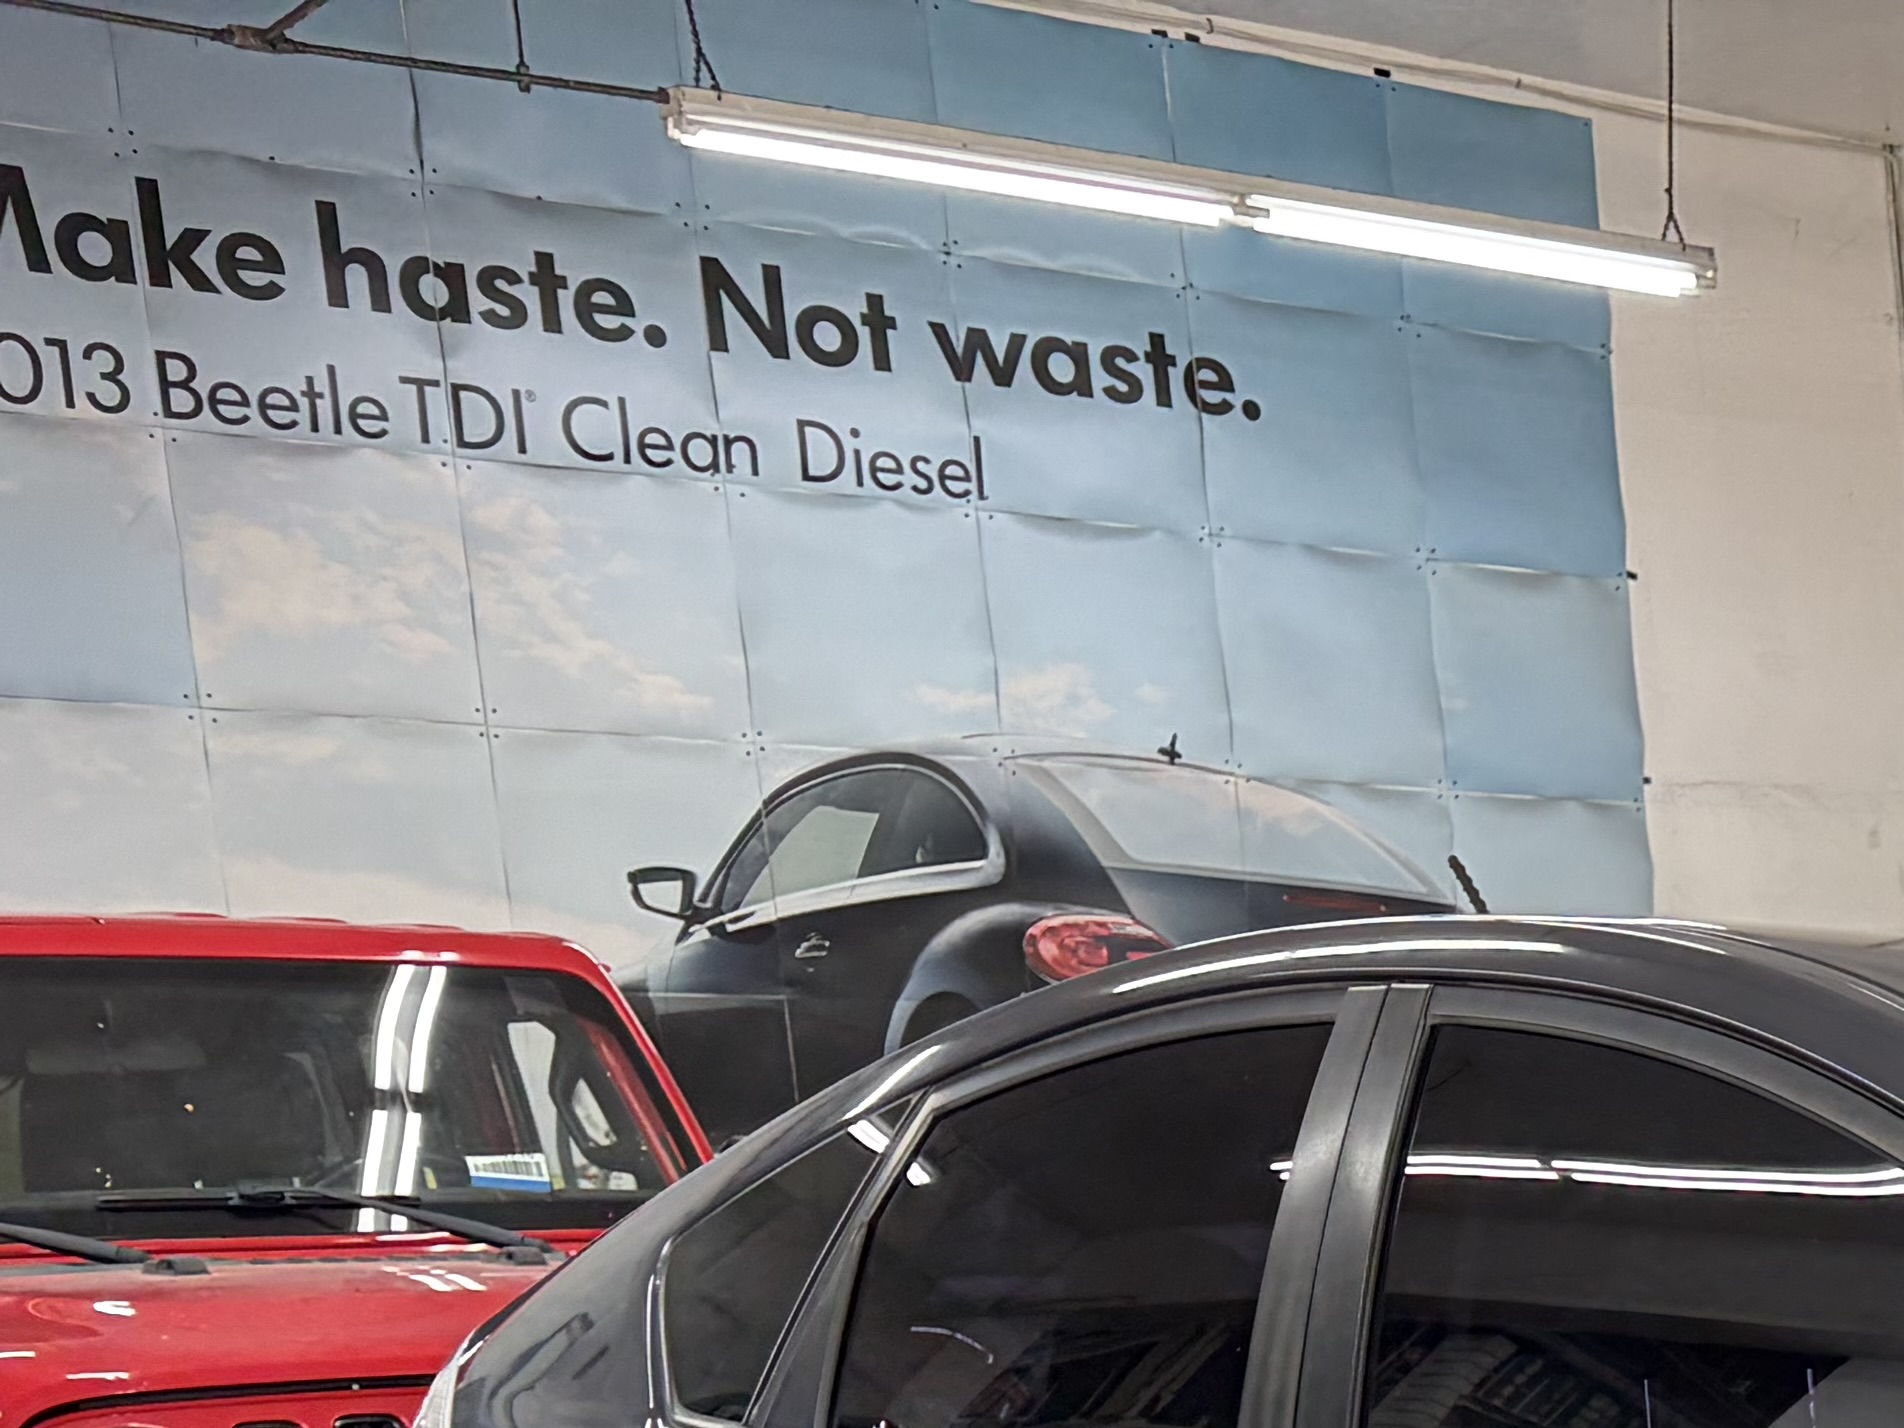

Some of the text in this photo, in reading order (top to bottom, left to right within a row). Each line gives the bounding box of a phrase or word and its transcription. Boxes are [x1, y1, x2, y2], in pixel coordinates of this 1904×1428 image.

[314, 200, 668, 349] haste.
[699, 255, 897, 372] Not
[928, 320, 1261, 421] waste.
[155, 350, 390, 439] Beetle
[562, 396, 759, 476] Clean
[796, 418, 989, 501] Diesel
